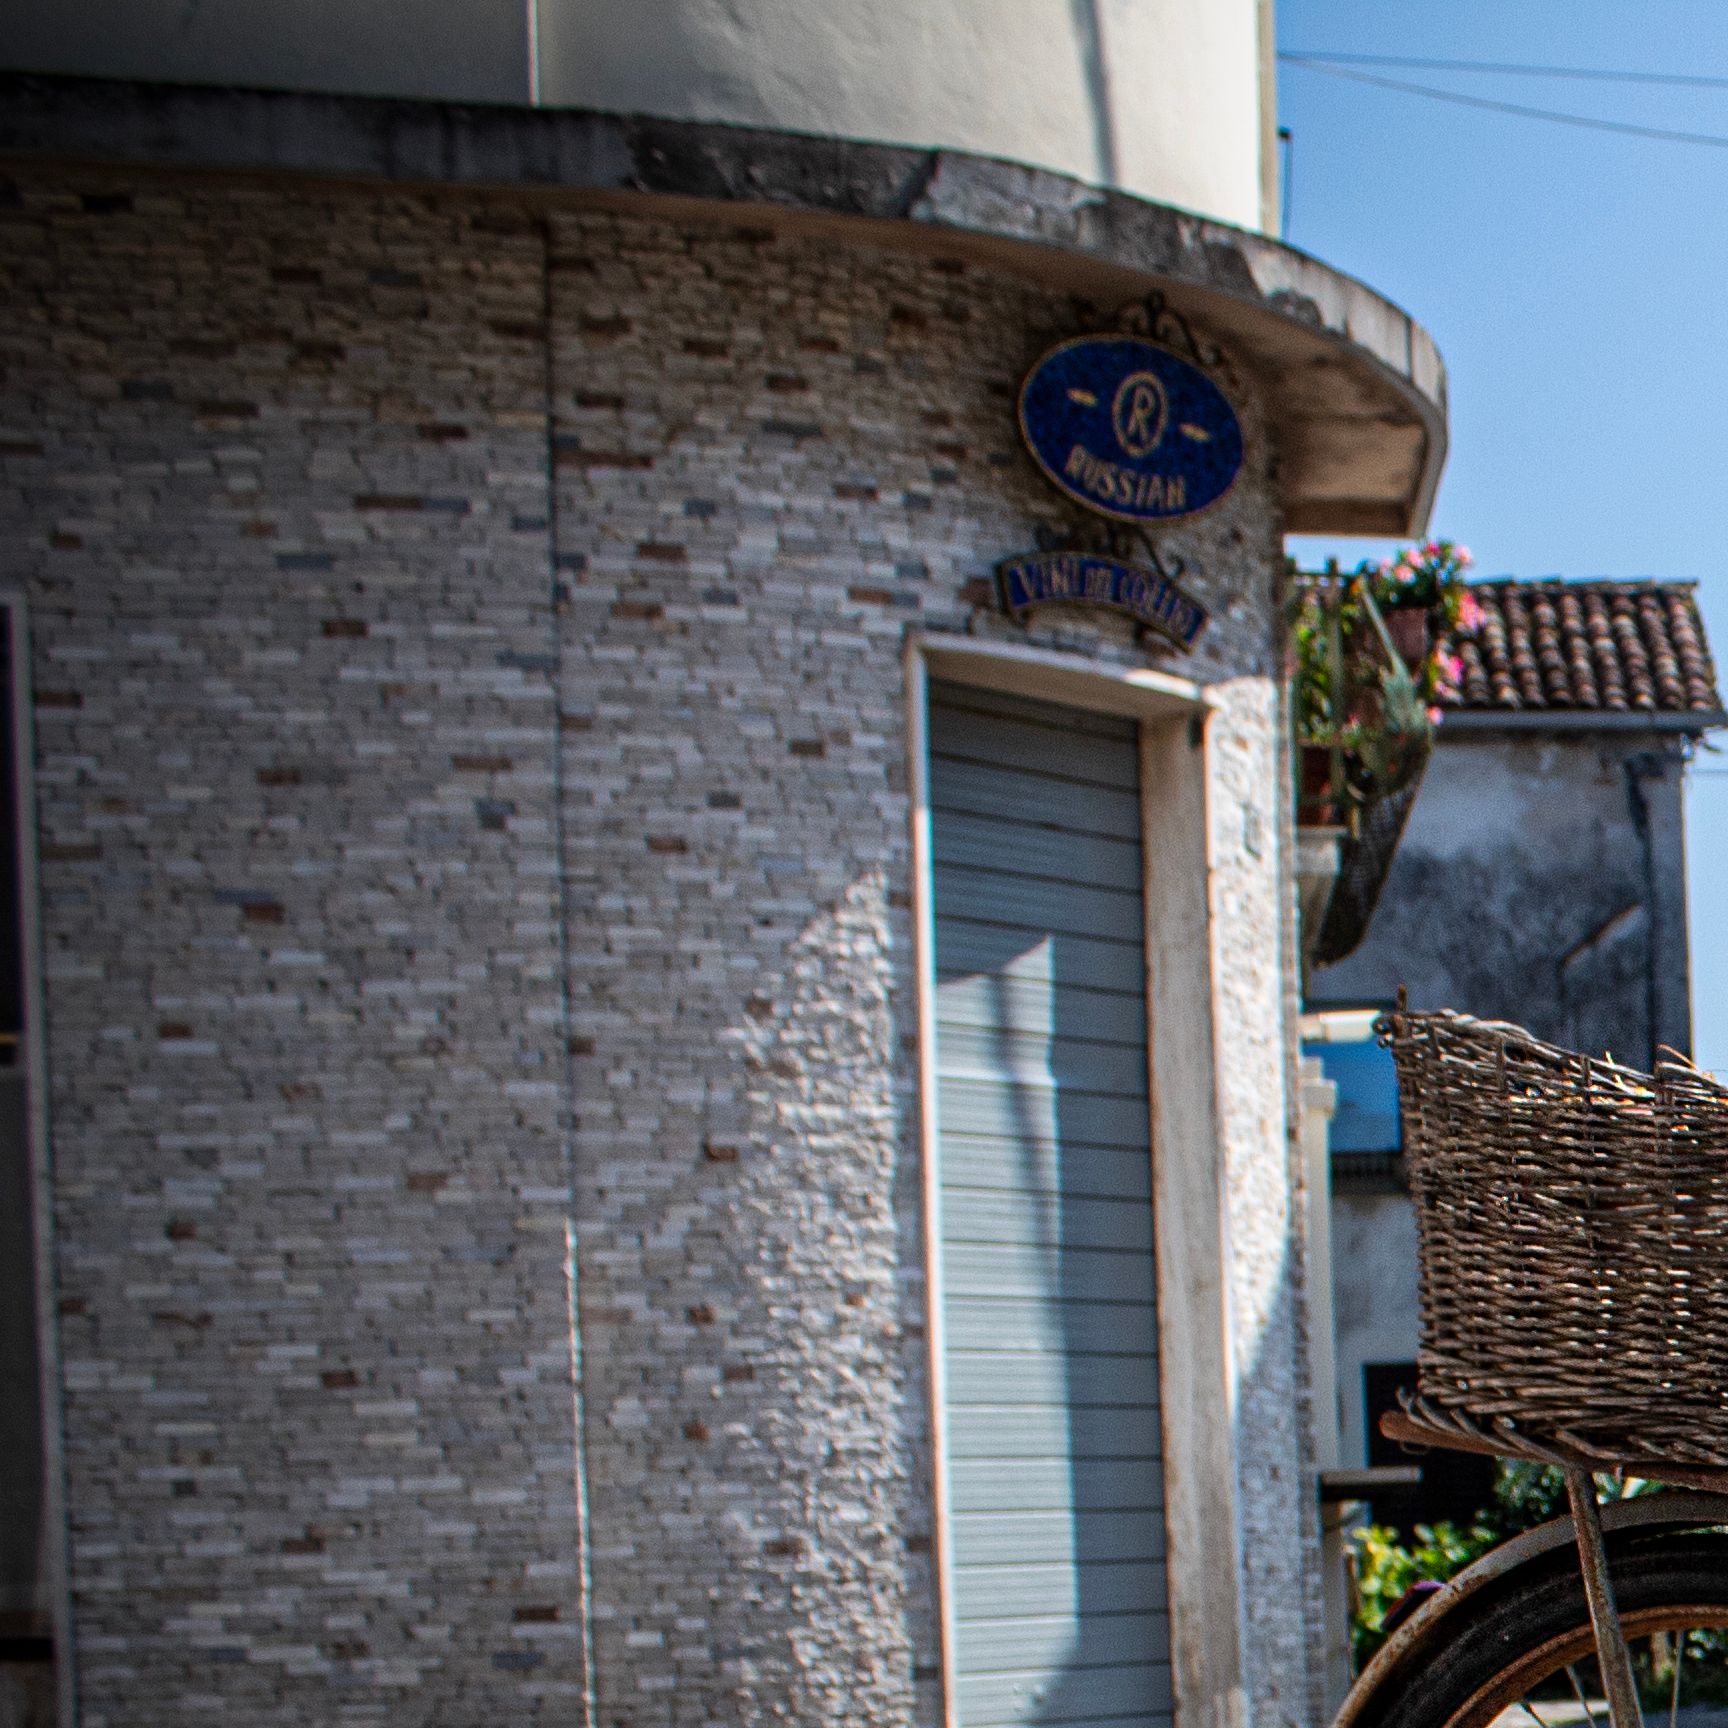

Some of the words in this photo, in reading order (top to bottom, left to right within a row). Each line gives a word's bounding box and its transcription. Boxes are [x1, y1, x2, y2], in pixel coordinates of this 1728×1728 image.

[1128, 385, 1157, 445] R
[1064, 443, 1186, 511] RUSSIAN
[1016, 556, 1081, 600] VINI
